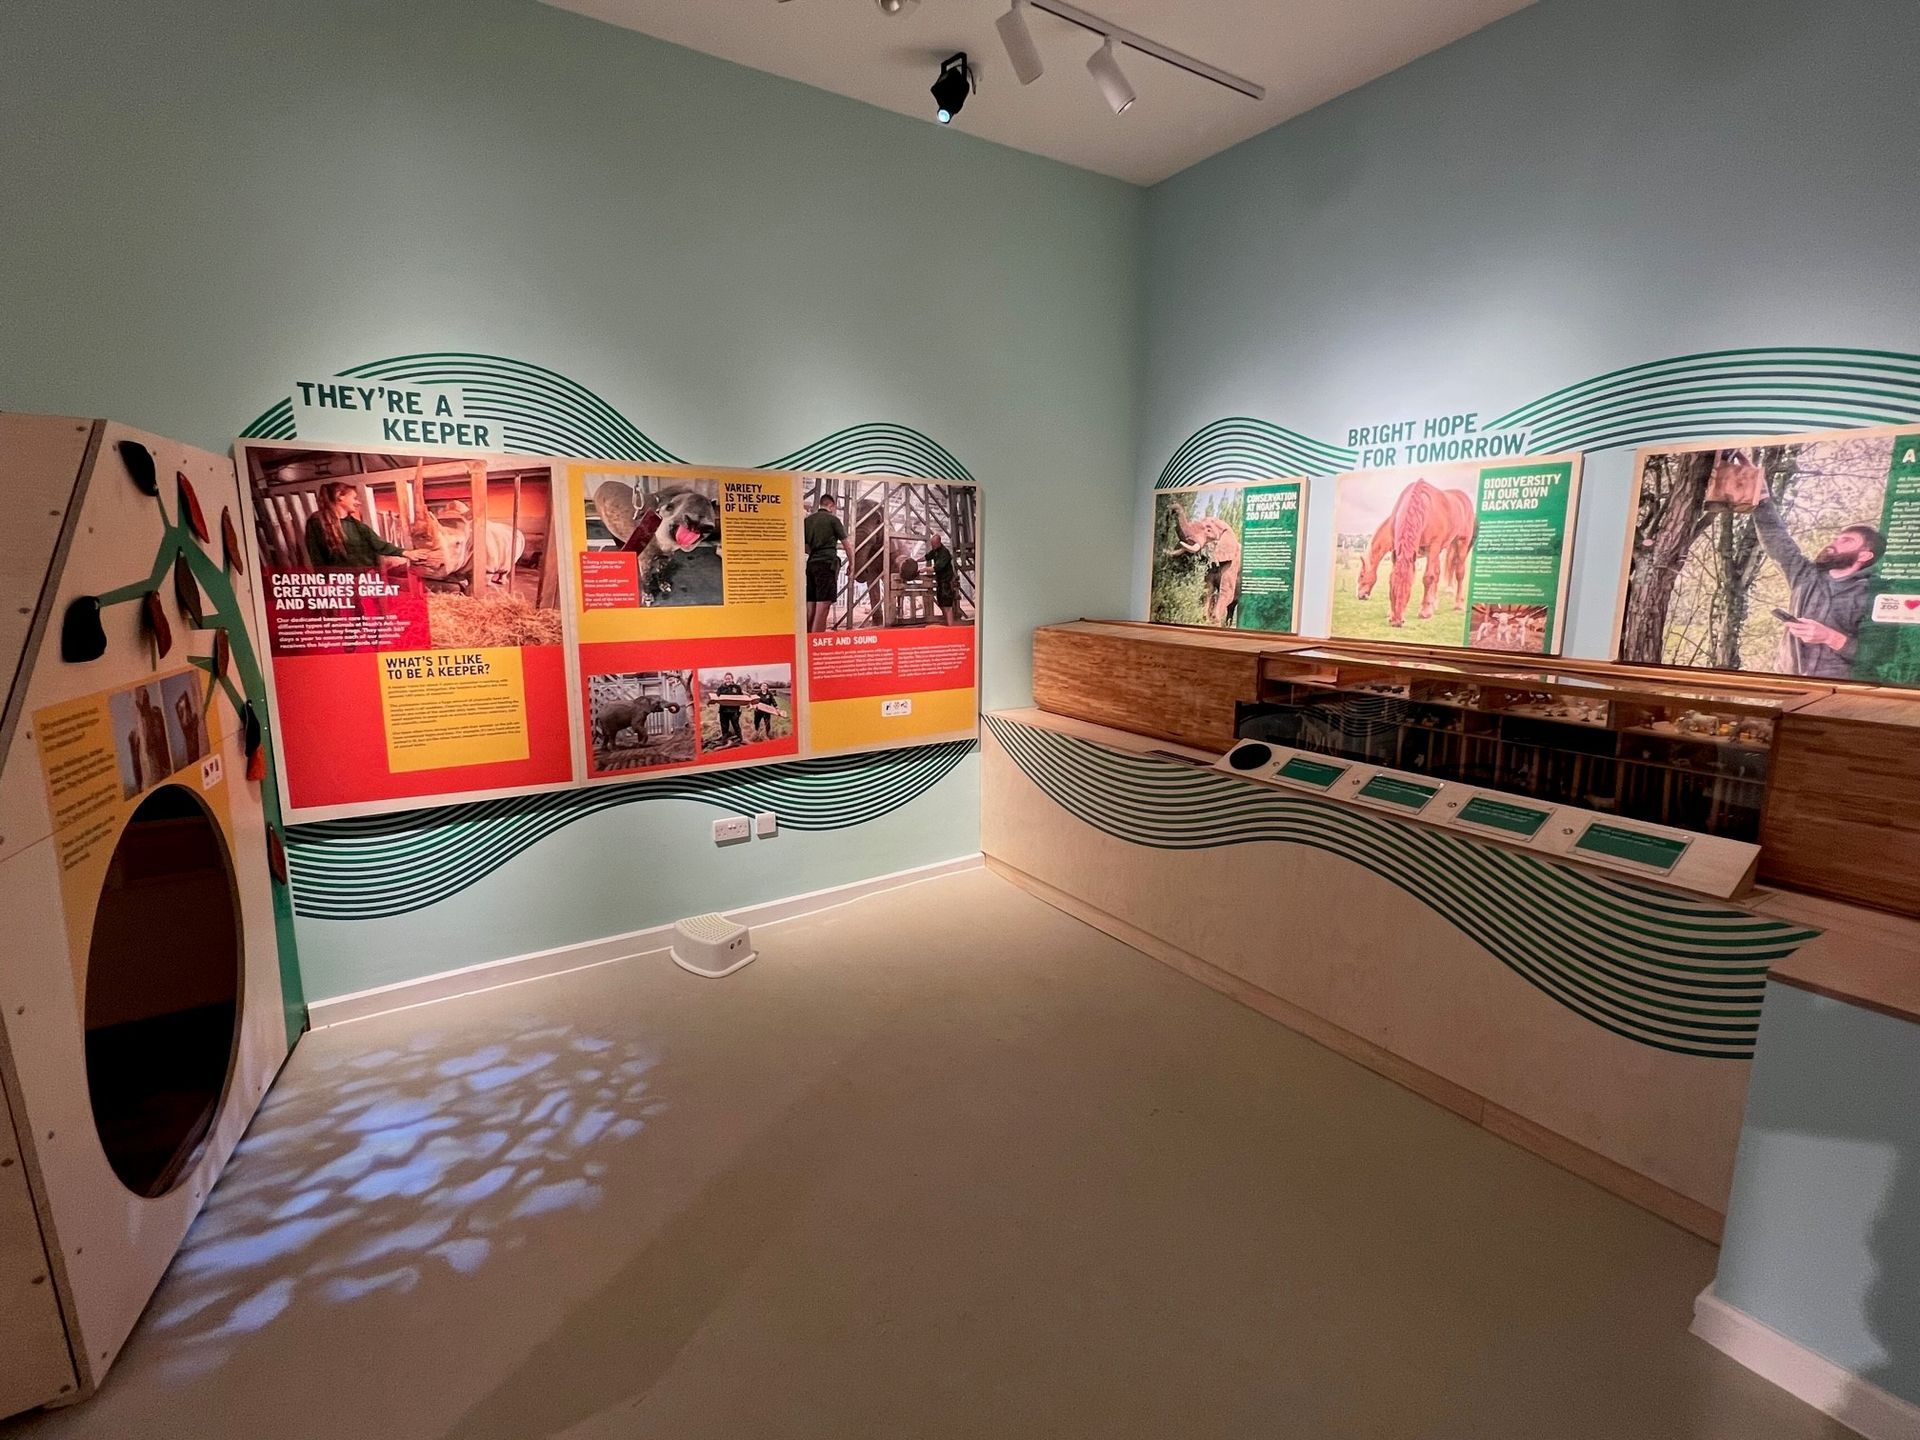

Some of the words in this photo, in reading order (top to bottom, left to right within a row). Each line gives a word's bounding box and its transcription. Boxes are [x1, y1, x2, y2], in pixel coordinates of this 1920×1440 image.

[296, 381, 423, 416] THEY'RE
[435, 394, 453, 417] A
[383, 418, 490, 447] KEEPER
[1347, 420, 1416, 448] BRIGHT
[1423, 412, 1479, 438] HOPE
[1362, 446, 1396, 469] FOR
[1407, 433, 1526, 466] TOMORROW
[1902, 448, 1916, 463] A
[1483, 473, 1562, 489] BIODIVERSITY
[725, 483, 762, 493] VARIETY
[1483, 489, 1495, 500] IN
[1497, 488, 1519, 499] OUR
[1521, 486, 1548, 498] OWN
[725, 493, 735, 502] IS
[736, 494, 754, 503] THE
[756, 494, 781, 504] SPICE
[1247, 491, 1297, 503] CONSERVATION
[725, 503, 736, 512] OF
[738, 504, 759, 513] LIFE
[1246, 503, 1256, 511] AT
[1256, 501, 1281, 511] NOAH'S
[1281, 500, 1297, 510] ARK
[1481, 498, 1539, 511] BACKYARD
[1246, 511, 1259, 521] ZOO
[1260, 510, 1280, 520] FARM
[272, 573, 326, 586] CARING
[328, 573, 355, 585] FOR
[358, 573, 385, 585] ALL
[273, 585, 354, 598] CREATURES
[358, 585, 400, 597] GREAT
[276, 598, 305, 610] AND
[307, 598, 356, 610] SMALL
[812, 637, 833, 647] SAFE
[835, 636, 851, 646] AND
[853, 635, 878, 645] SOUND
[386, 656, 433, 668] WHAT'S
[438, 655, 450, 666] IT
[454, 654, 483, 665] LIKE
[387, 669, 403, 680] TO
[407, 668, 423, 679] BE
[427, 667, 435, 678] A
[438, 663, 491, 677] KEEPER?
